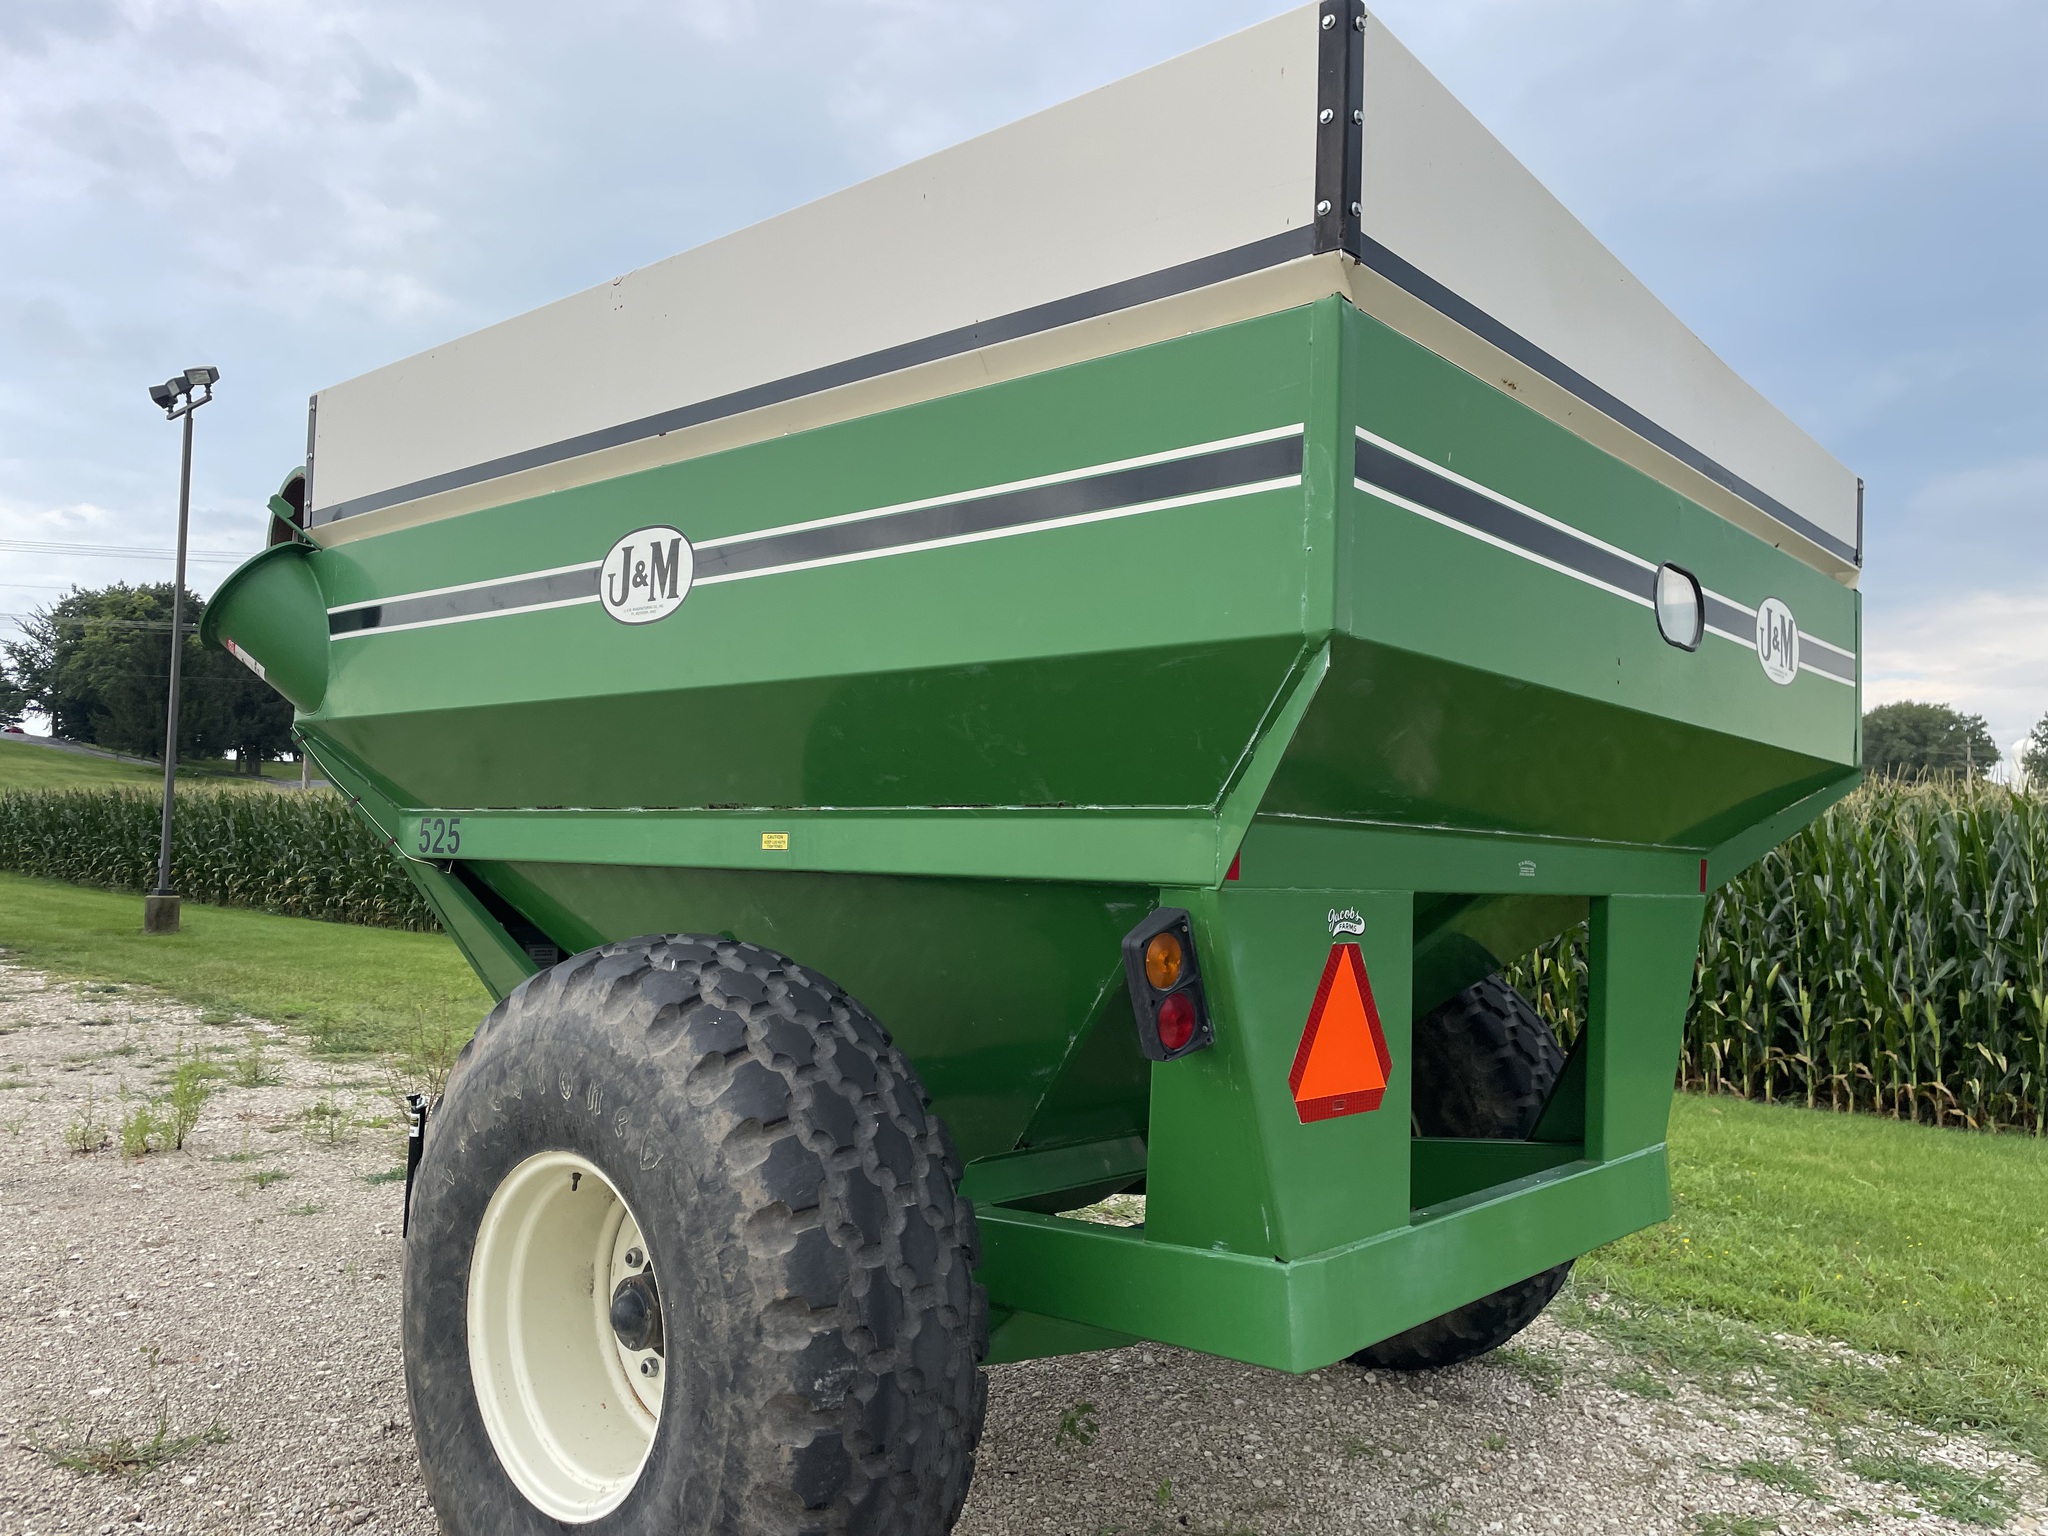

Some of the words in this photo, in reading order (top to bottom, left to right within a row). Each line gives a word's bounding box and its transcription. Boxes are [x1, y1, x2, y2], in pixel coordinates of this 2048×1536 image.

[608, 537, 682, 607] J&M
[1760, 607, 1794, 672] J&M
[418, 817, 461, 854] 525
[1339, 923, 1357, 932] FARMS
